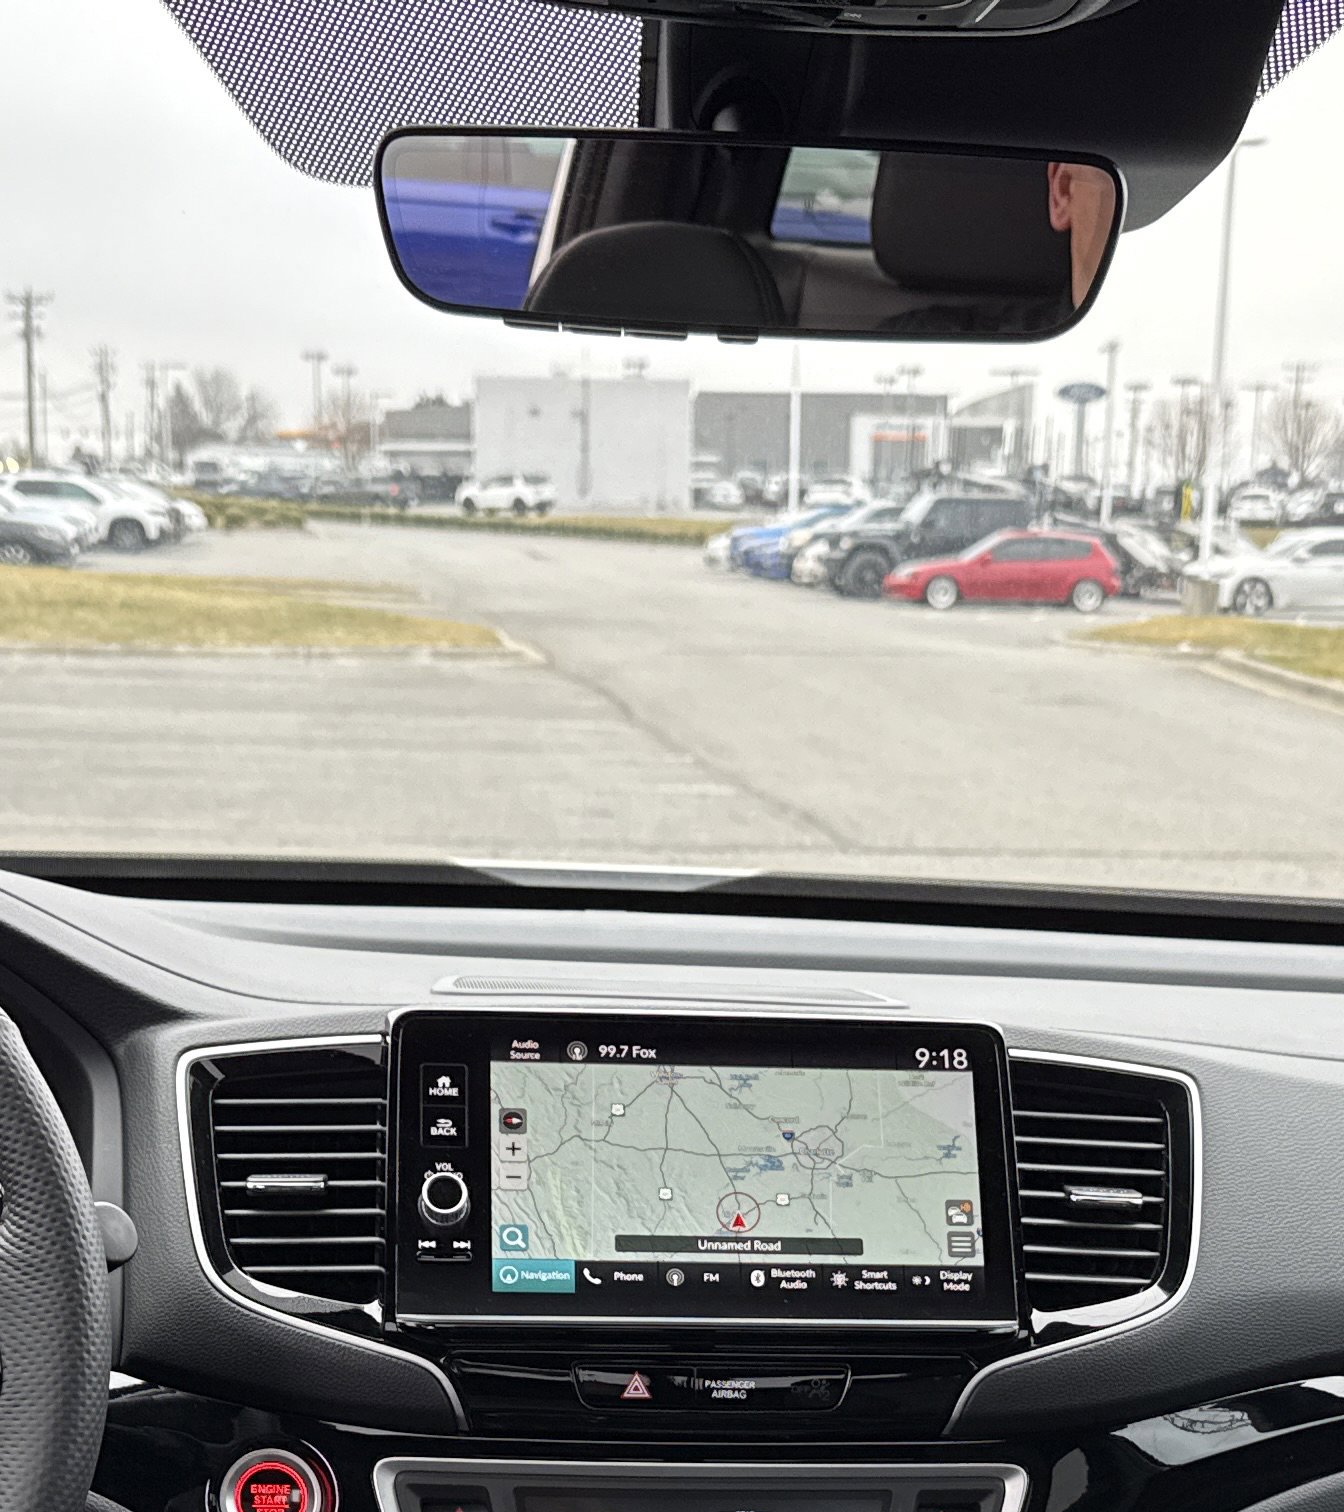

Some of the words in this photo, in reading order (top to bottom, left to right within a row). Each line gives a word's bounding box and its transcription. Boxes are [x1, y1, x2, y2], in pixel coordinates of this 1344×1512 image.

[511, 1040, 539, 1049] Audio
[510, 1050, 540, 1060] Source
[598, 1045, 629, 1058] 99.7
[632, 1046, 657, 1059] Fox
[915, 1047, 968, 1070] 9:18
[429, 1087, 459, 1097] HOME
[430, 1126, 458, 1136] BACK
[435, 1162, 454, 1171] VOL
[698, 1239, 752, 1250] Unnamed
[754, 1240, 782, 1251] Road
[520, 1271, 570, 1283] Navigation
[614, 1271, 644, 1282] Phone
[703, 1273, 720, 1282] FM
[771, 1268, 816, 1279] Bluetooth
[861, 1270, 888, 1279] Smart
[940, 1270, 973, 1282] Display
[780, 1279, 808, 1290] Audio
[854, 1280, 897, 1290] Shortcuts
[943, 1281, 971, 1292] Mode
[705, 1380, 756, 1389] PASSENGER
[711, 1390, 747, 1399] AIRBAG
[250, 1484, 291, 1494] ENGINE
[254, 1495, 287, 1504] START
